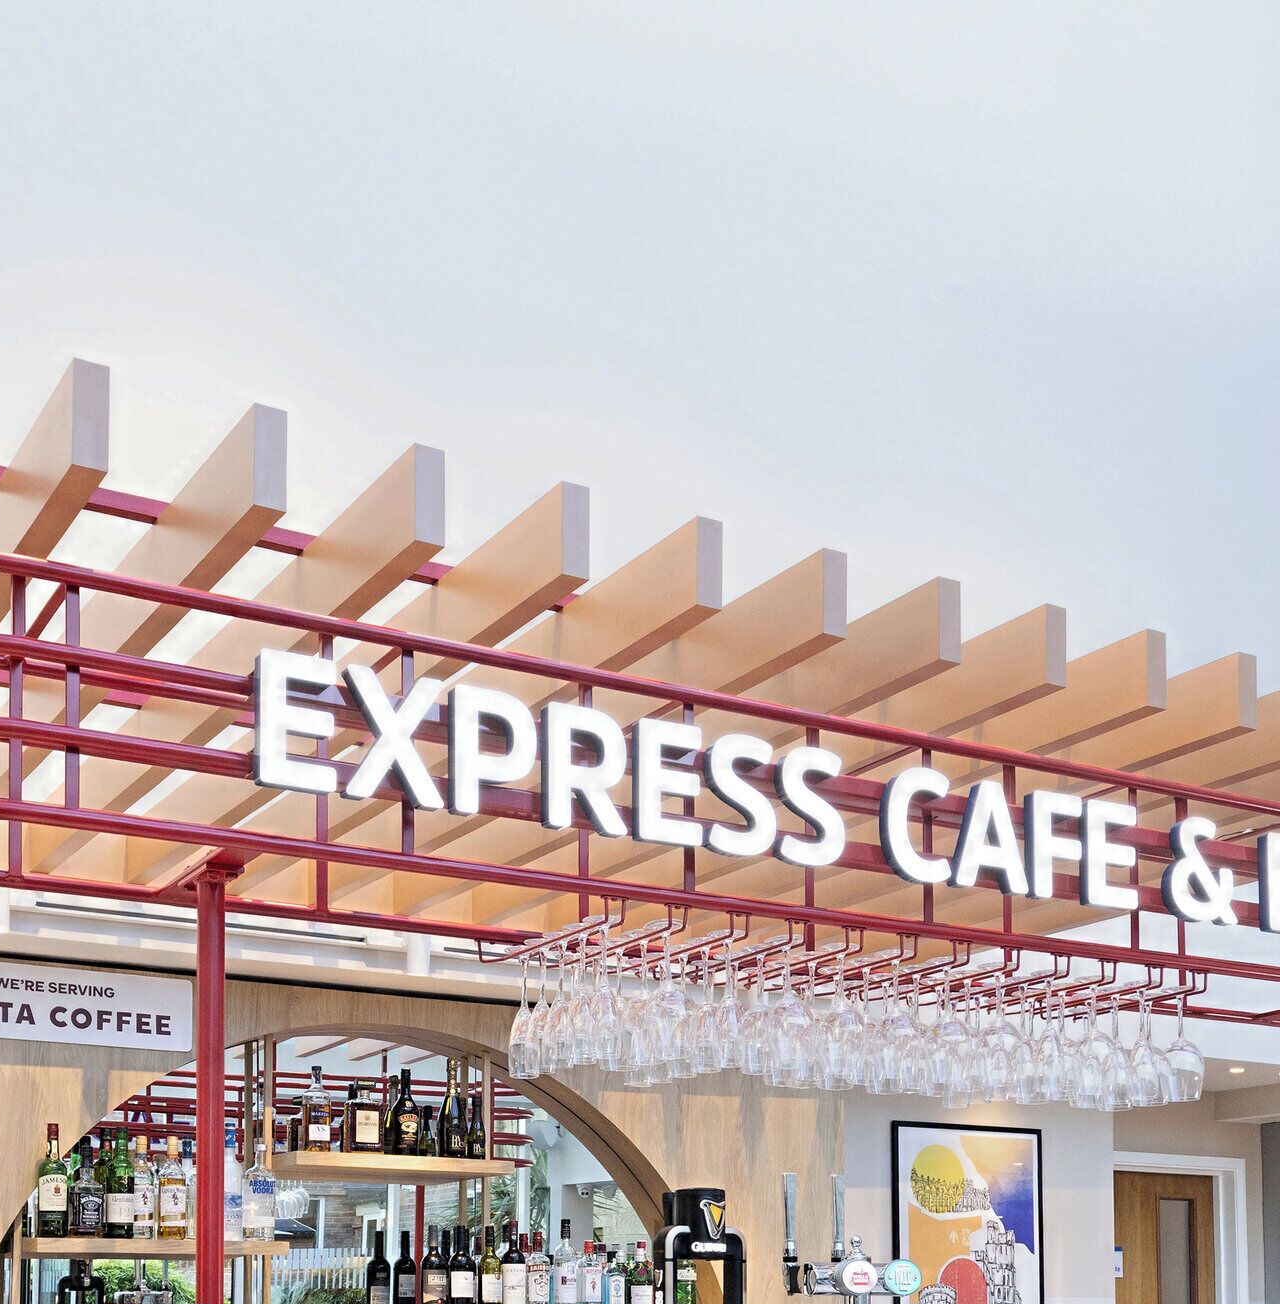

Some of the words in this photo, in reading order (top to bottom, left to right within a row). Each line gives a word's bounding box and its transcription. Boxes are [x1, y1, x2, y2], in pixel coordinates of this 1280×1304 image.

[254, 648, 846, 867] EXPRESS
[880, 766, 1140, 911] CAFE
[1162, 817, 1238, 926] &
[48, 981, 115, 998] SERVING
[49, 1006, 172, 1036] COFFEE
[41, 1177, 67, 1186] JAMESO
[252, 1187, 273, 1195] VODKA
